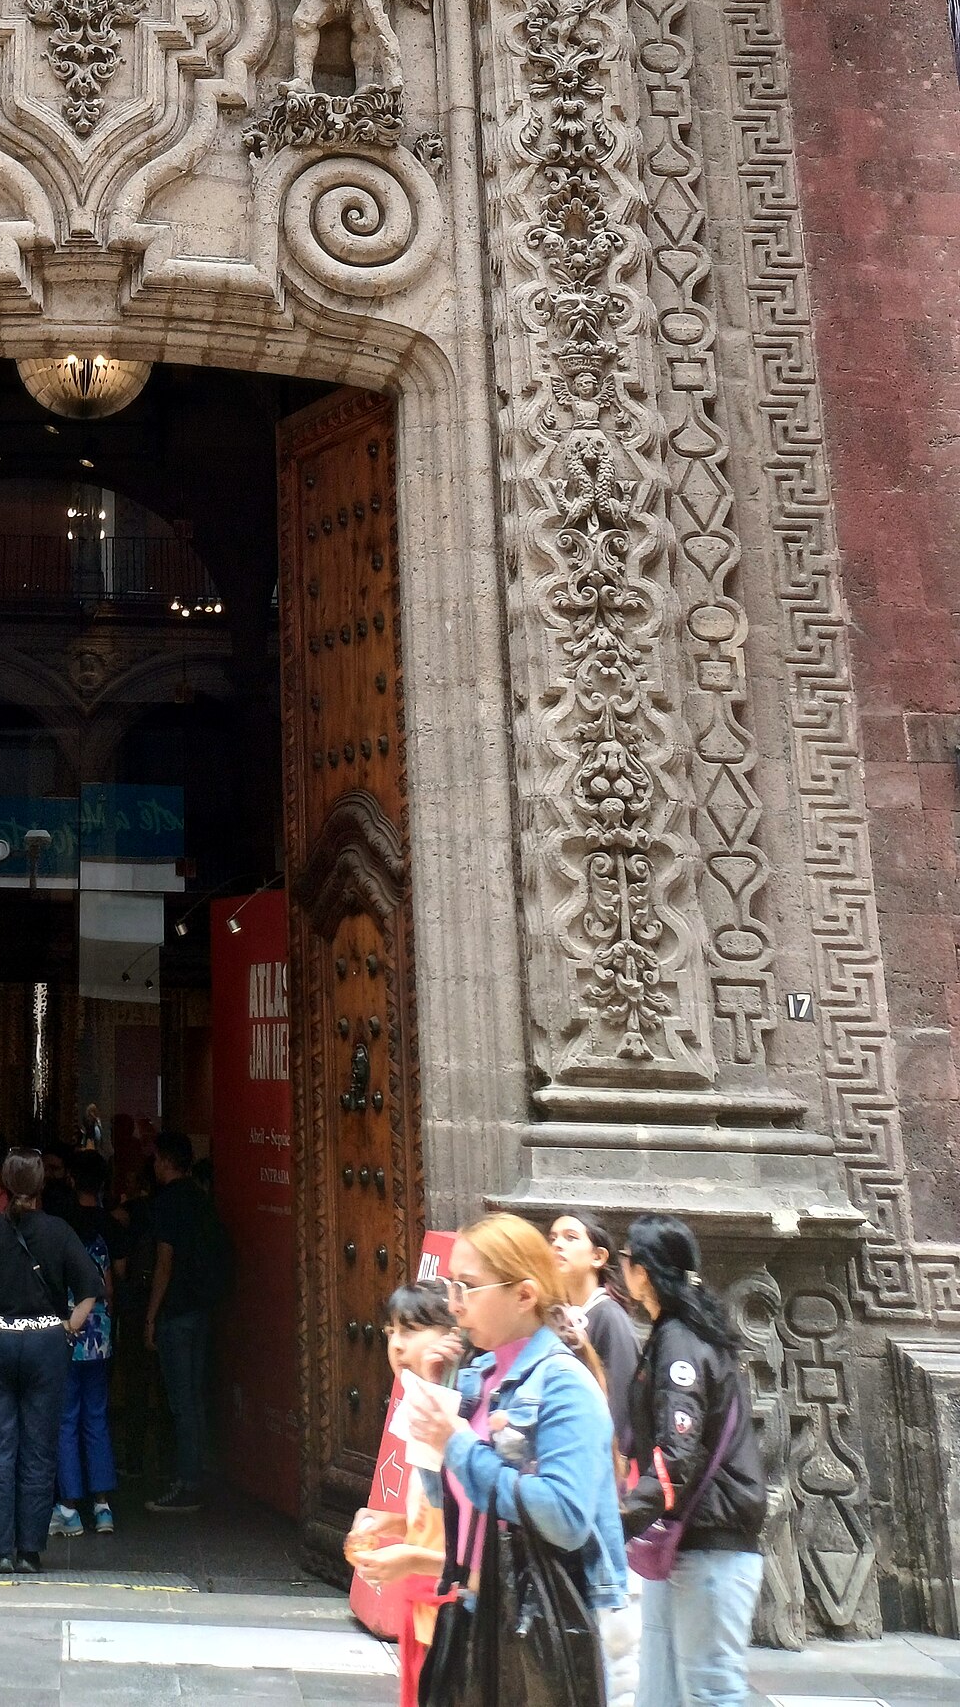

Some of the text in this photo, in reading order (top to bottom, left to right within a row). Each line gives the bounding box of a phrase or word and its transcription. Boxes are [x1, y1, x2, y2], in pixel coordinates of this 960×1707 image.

[787, 994, 811, 1018] 17
[249, 1023, 270, 1080] JAN
[259, 1166, 290, 1185] ENTRADA
